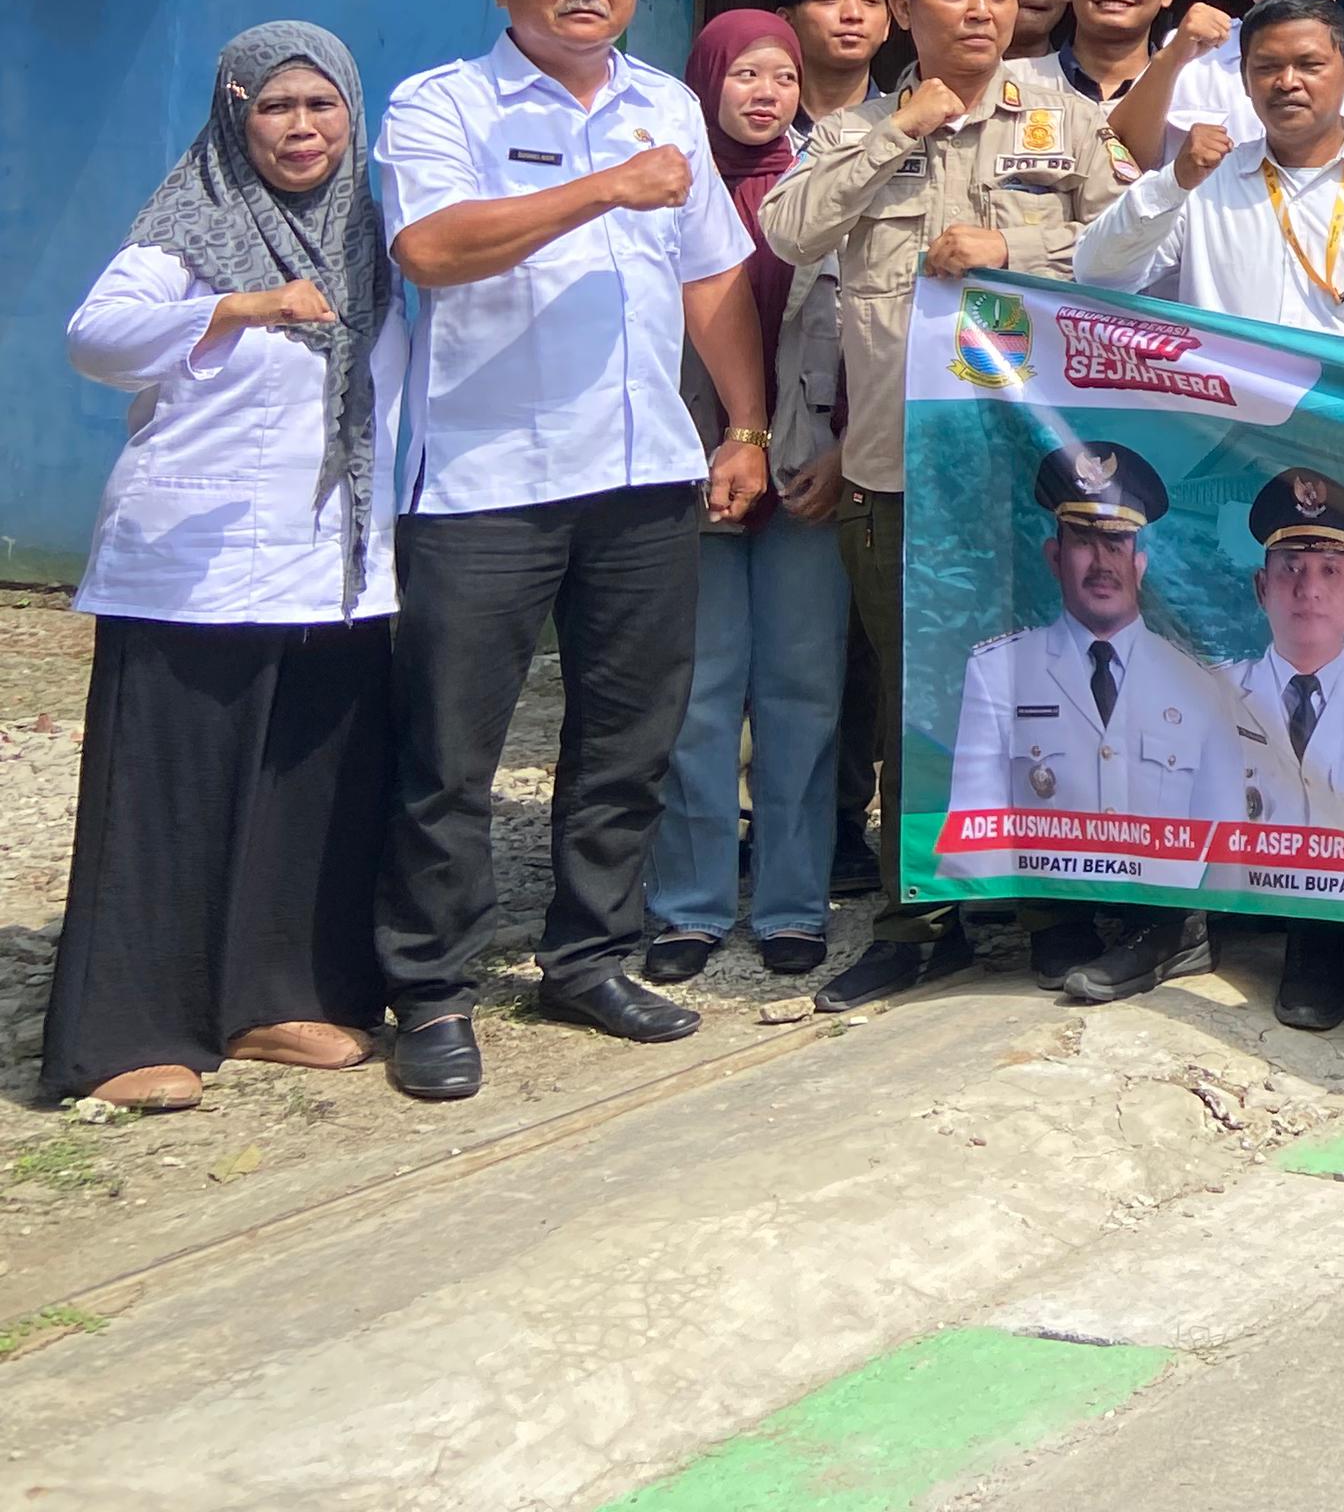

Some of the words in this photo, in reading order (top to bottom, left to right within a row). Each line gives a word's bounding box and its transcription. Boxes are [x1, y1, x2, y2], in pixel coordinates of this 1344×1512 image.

[1059, 308, 1136, 328] KABUPATEN
[1060, 319, 1193, 352] BANGKIT
[1070, 337, 1137, 364] MAJU
[1069, 356, 1225, 398] SEJAHTERA
[961, 815, 998, 840] ADE
[1002, 813, 1083, 842] KUSWARA
[1085, 820, 1152, 847] KUNANG
[1163, 824, 1196, 850] S.H.
[1227, 829, 1252, 853] dr.
[1255, 831, 1304, 857] ASEP
[1017, 854, 1080, 873] BUPATI
[1081, 856, 1143, 878] BEKASI
[1247, 870, 1301, 892] WAKIL
